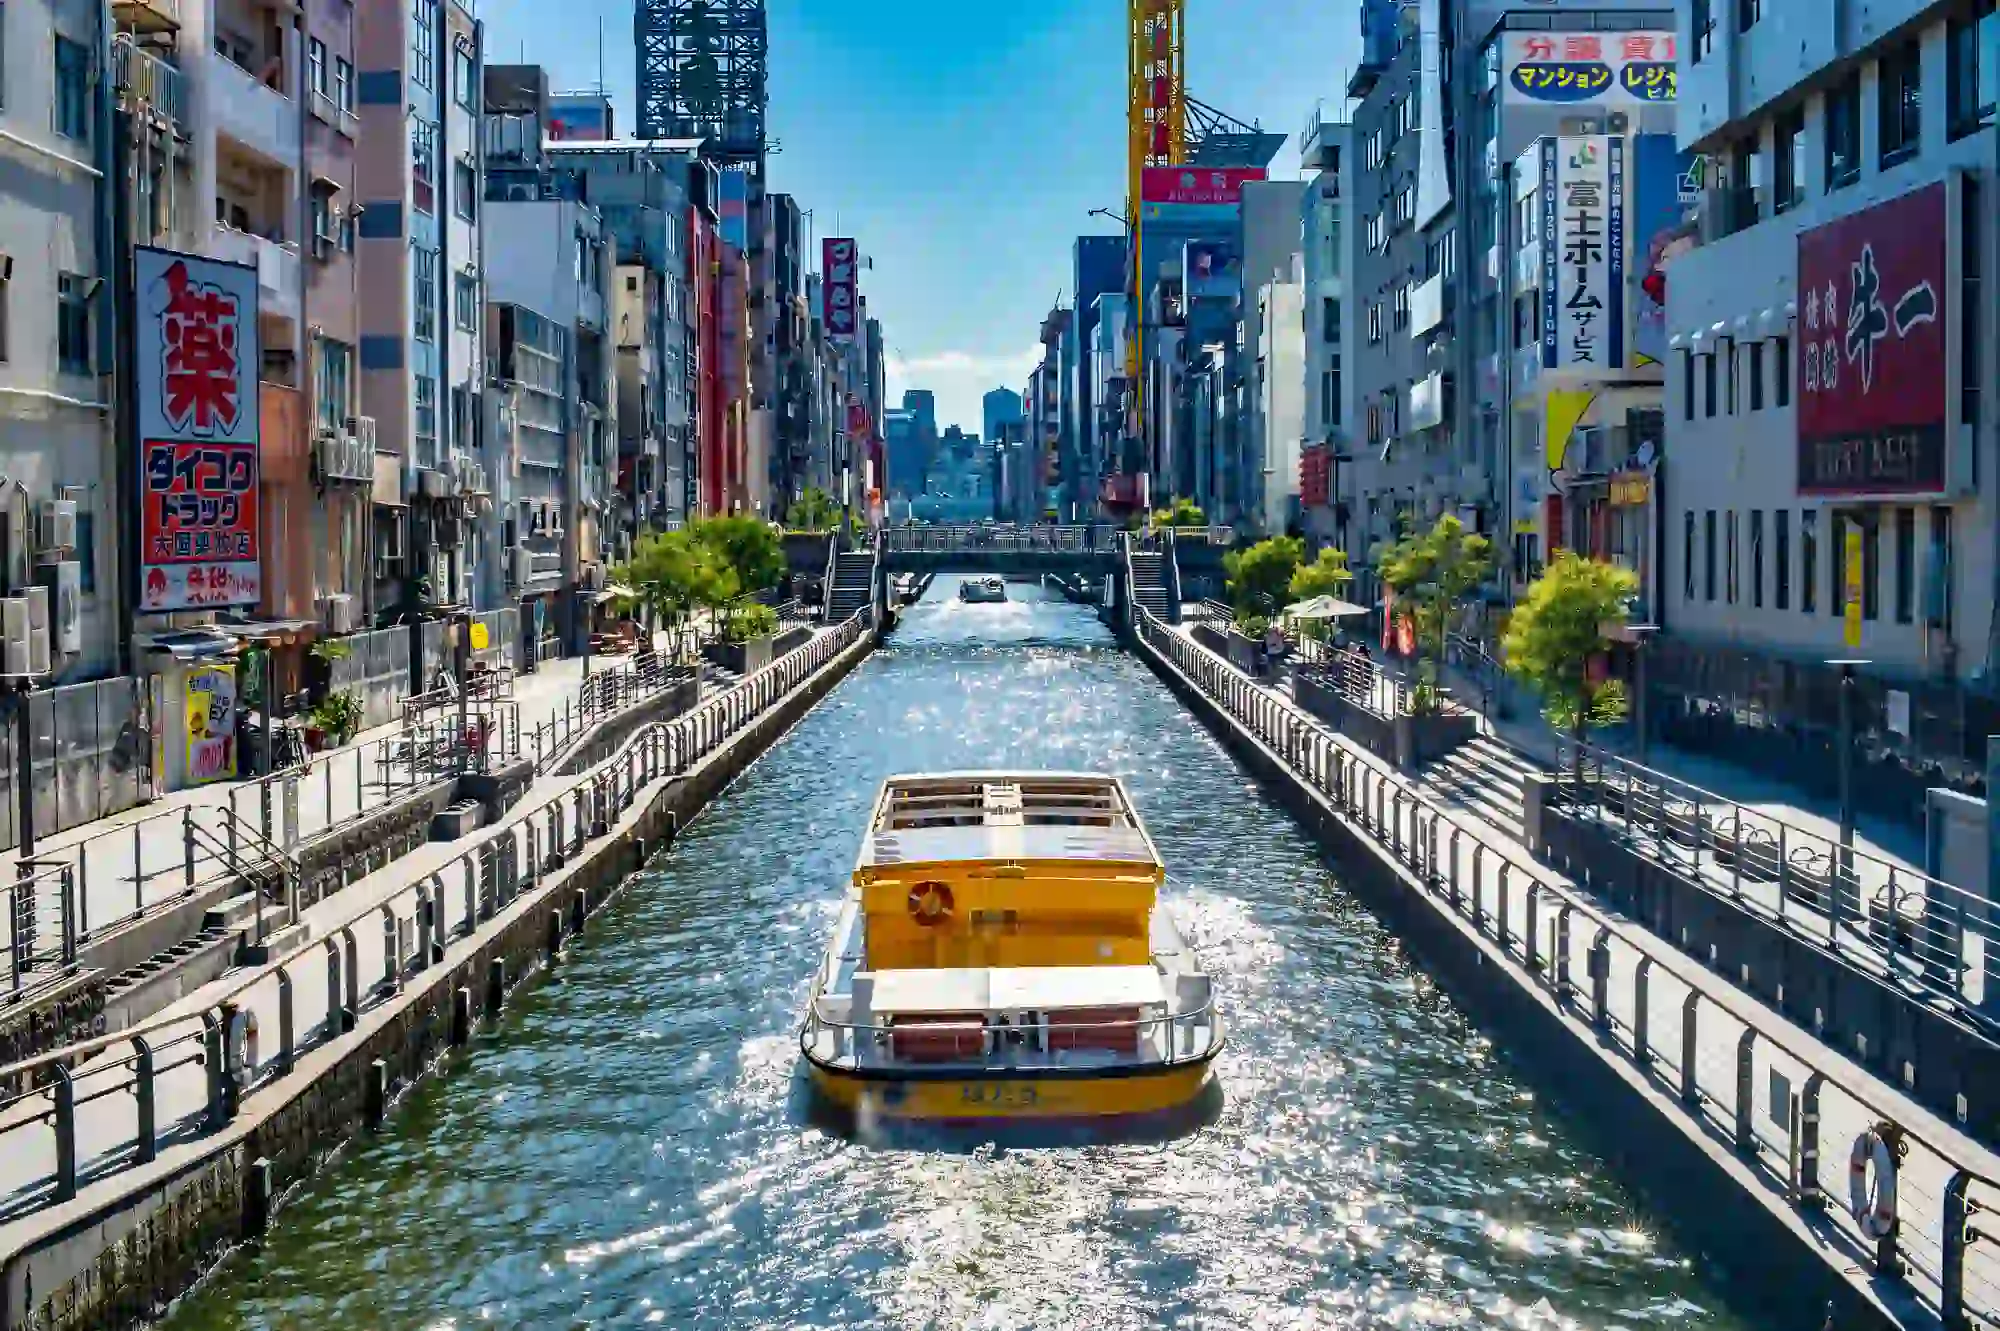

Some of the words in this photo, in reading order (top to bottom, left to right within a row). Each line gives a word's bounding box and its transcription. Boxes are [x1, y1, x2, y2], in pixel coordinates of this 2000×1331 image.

[1517, 67, 1609, 88] マンション
[1563, 178, 1603, 363] 富士ホームサービス
[164, 276, 238, 430] 薬
[147, 445, 255, 492] ダイコク
